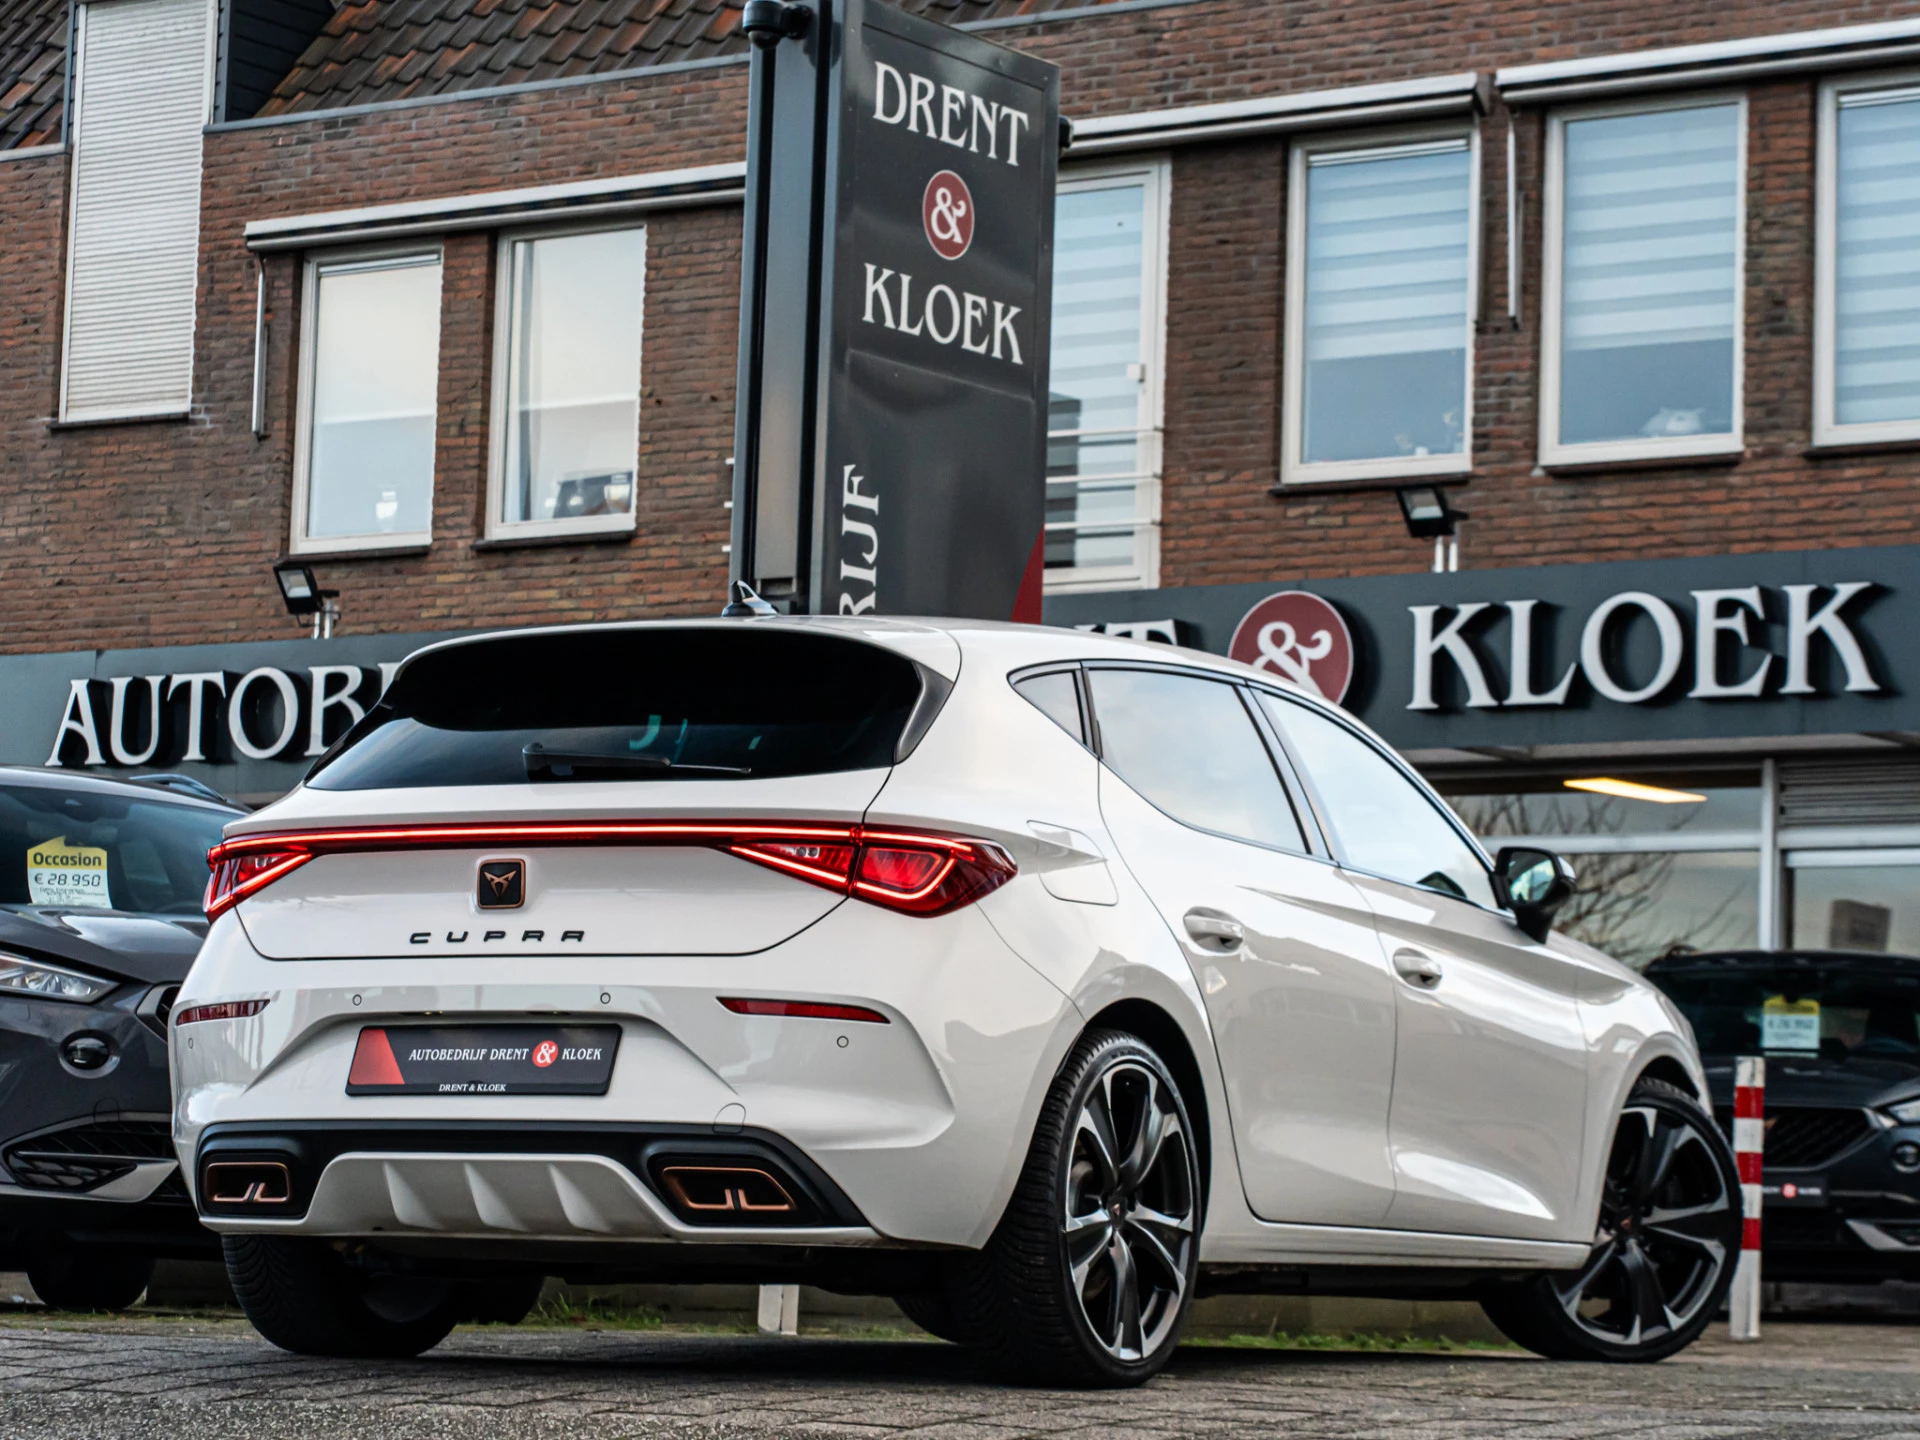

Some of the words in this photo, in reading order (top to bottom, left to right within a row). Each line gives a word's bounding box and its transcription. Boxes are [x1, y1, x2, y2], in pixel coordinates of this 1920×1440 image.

[872, 61, 1029, 167] DRENT
[930, 187, 966, 245] &
[862, 263, 1024, 365] KLOEK
[44, 662, 402, 767] AUTOB
[1251, 621, 1333, 701] &
[1405, 581, 1882, 711] KLOEK
[33, 852, 102, 866] Occasion
[34, 873, 44, 885] €
[47, 873, 102, 887] 28.950
[409, 930, 586, 944] CUPRA
[408, 1048, 488, 1061] AUTOBEDRIJF
[489, 1048, 529, 1061] DRENT
[536, 1042, 556, 1064] &
[561, 1048, 602, 1061] KLOEK
[438, 1083, 467, 1092] DRENT
[468, 1084, 476, 1092] &
[476, 1083, 507, 1093] KLOEK
